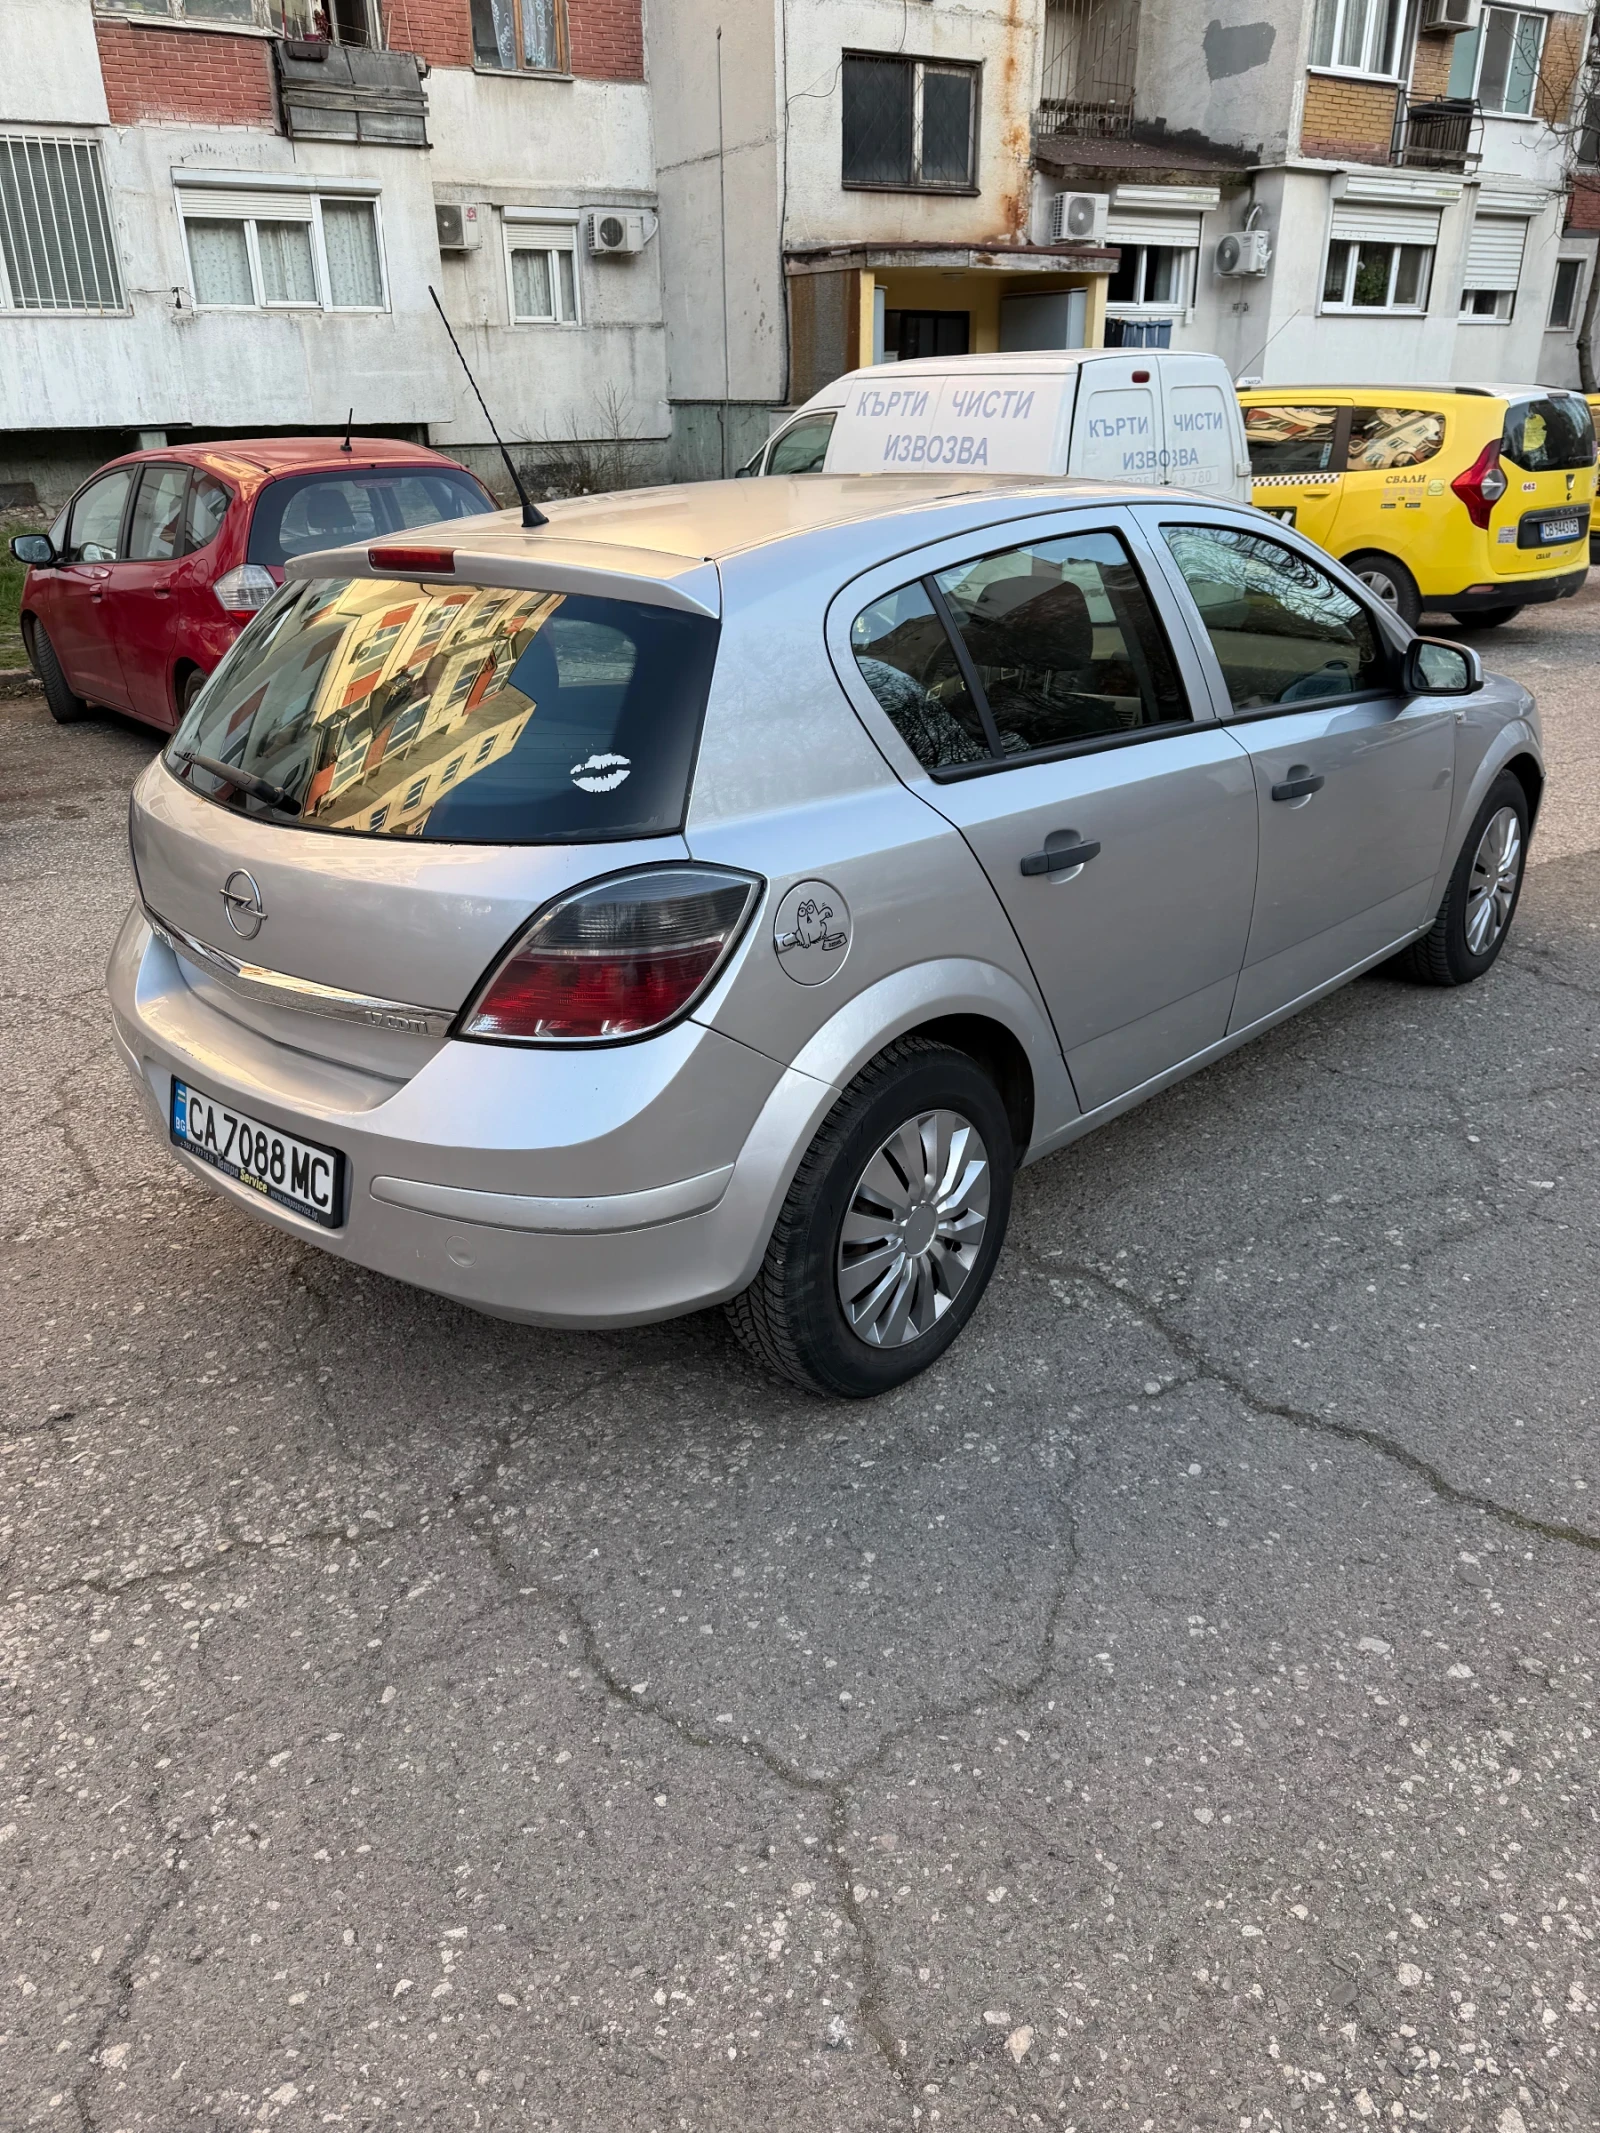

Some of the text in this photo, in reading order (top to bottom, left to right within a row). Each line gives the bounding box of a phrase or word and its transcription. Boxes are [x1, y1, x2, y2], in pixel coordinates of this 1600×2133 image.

[856, 390, 1035, 419] КЪРТИ ЧИСТИ
[1089, 412, 1223, 438] КЪРТИ ЧИСТИ
[883, 434, 988, 466] ИЗВОЗВА
[1123, 448, 1199, 470] ИЗВОЗВА
[175, 1116, 186, 1132] BG
[189, 1097, 330, 1208] CA 7088 MC
[217, 1156, 239, 1178] Tempo
[240, 1167, 268, 1194] Service
